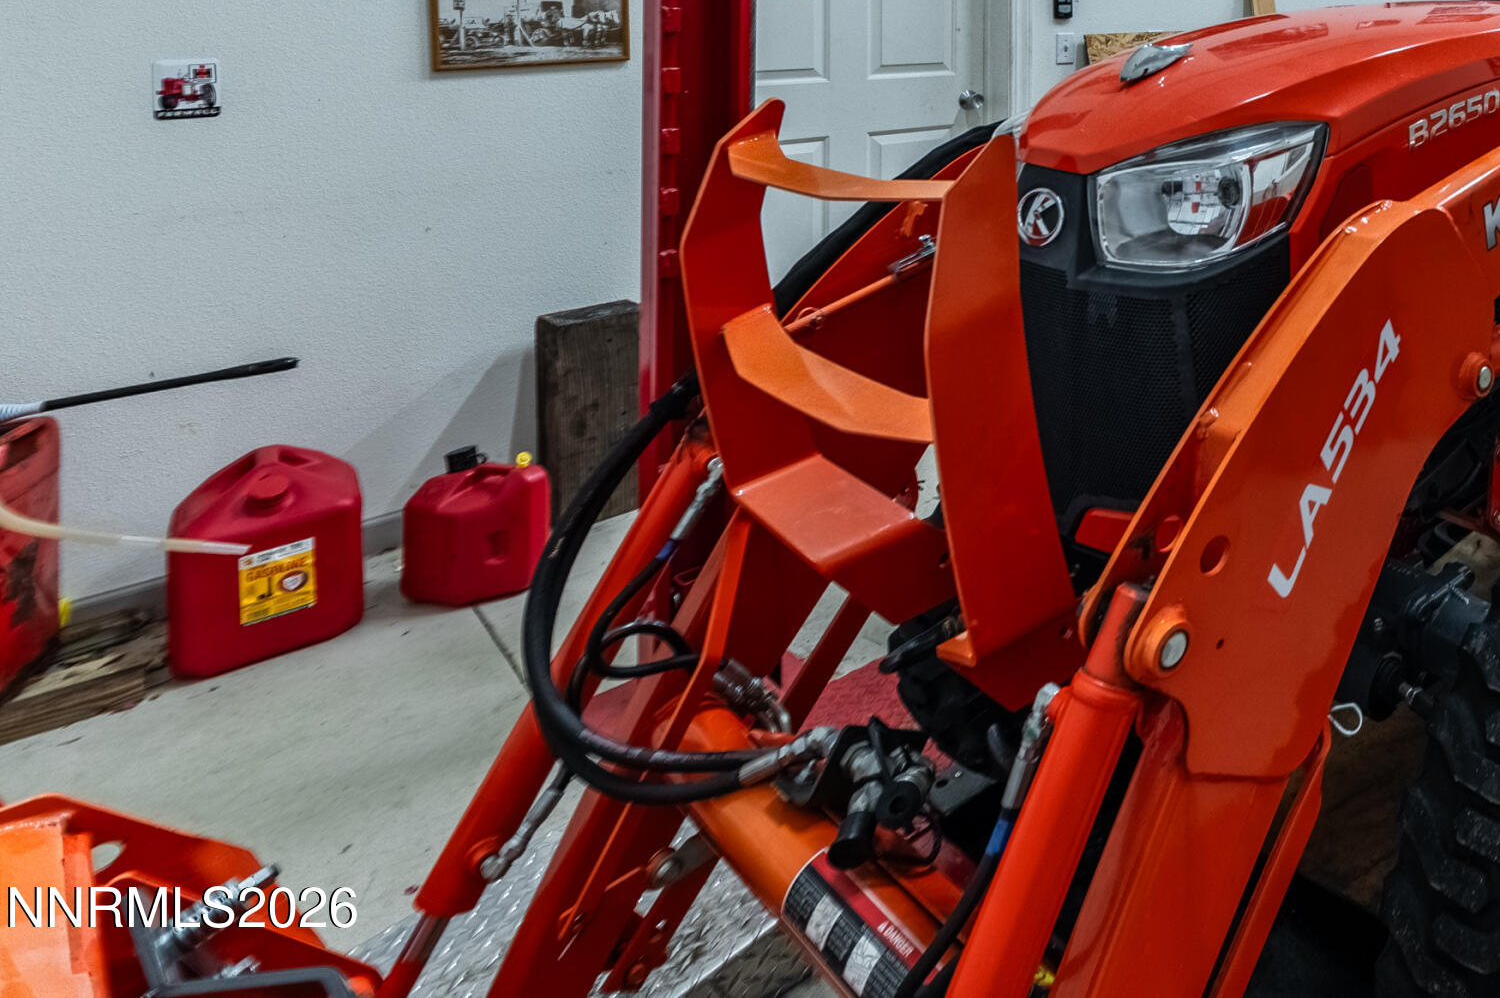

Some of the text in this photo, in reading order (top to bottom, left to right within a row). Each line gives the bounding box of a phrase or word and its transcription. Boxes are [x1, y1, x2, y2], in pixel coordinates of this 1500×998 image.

[1408, 89, 1500, 150] B2650
[1268, 319, 1400, 598] LA534
[884, 927, 914, 958] DANGER
